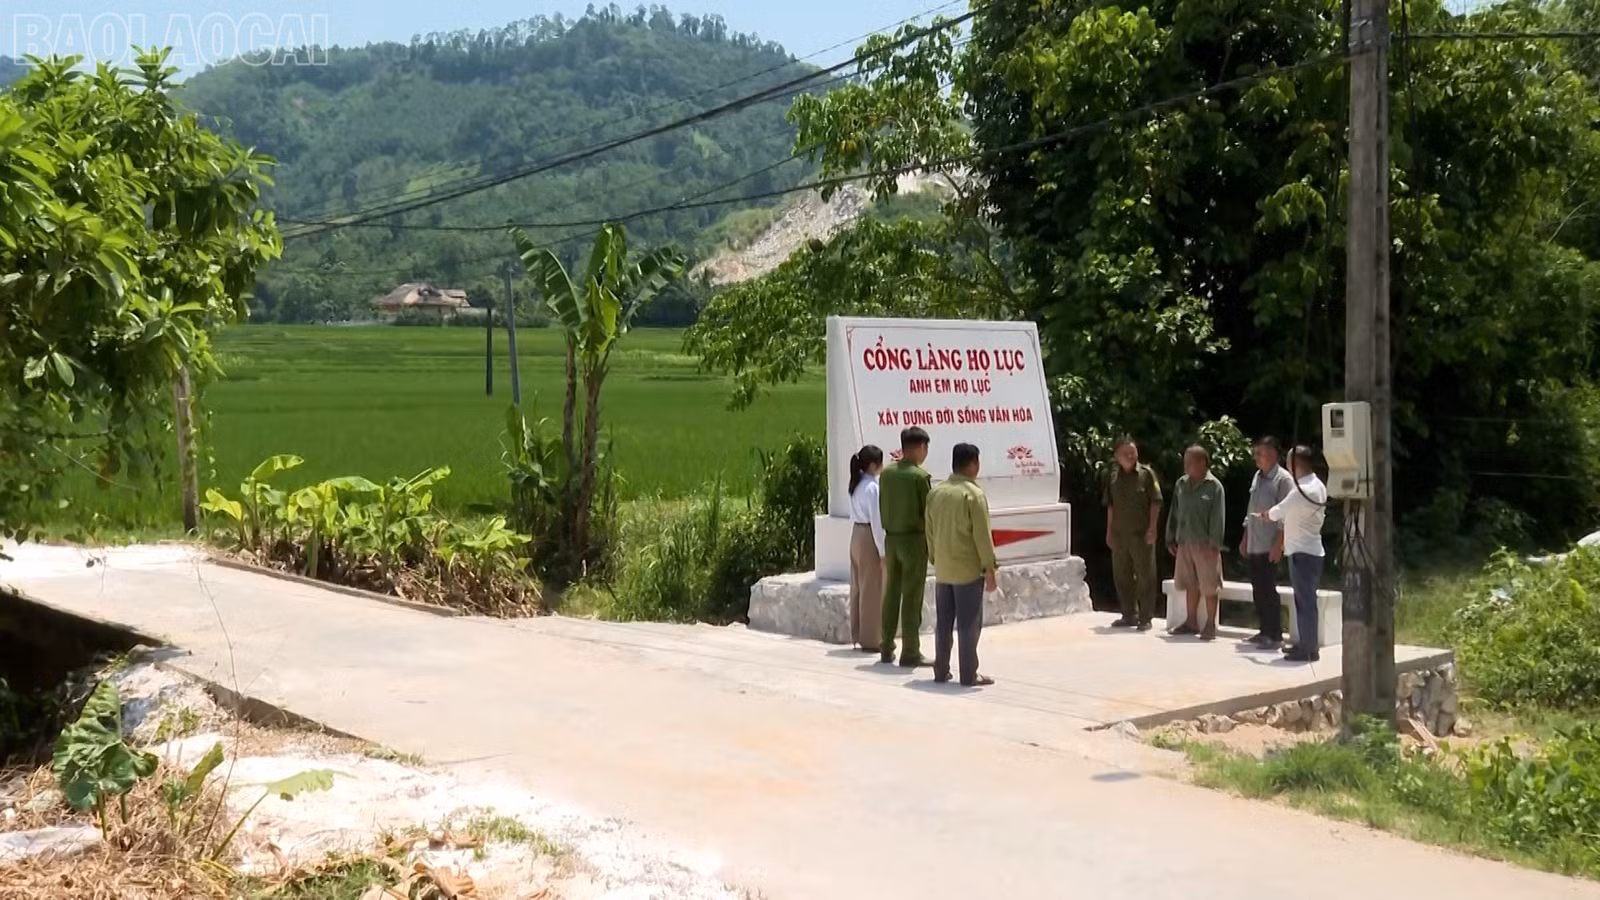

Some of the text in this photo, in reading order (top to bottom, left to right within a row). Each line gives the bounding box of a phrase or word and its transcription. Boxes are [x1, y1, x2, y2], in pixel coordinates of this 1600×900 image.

[863, 336, 1025, 376] CỔNG LÀNG HỌ LỤC
[909, 379, 992, 396] ANH EM HỌ LỤC
[878, 408, 900, 426] XÂY
[935, 407, 955, 424] ĐỜI
[957, 405, 987, 424] SỐNG
[1012, 407, 1033, 422] HÓA
